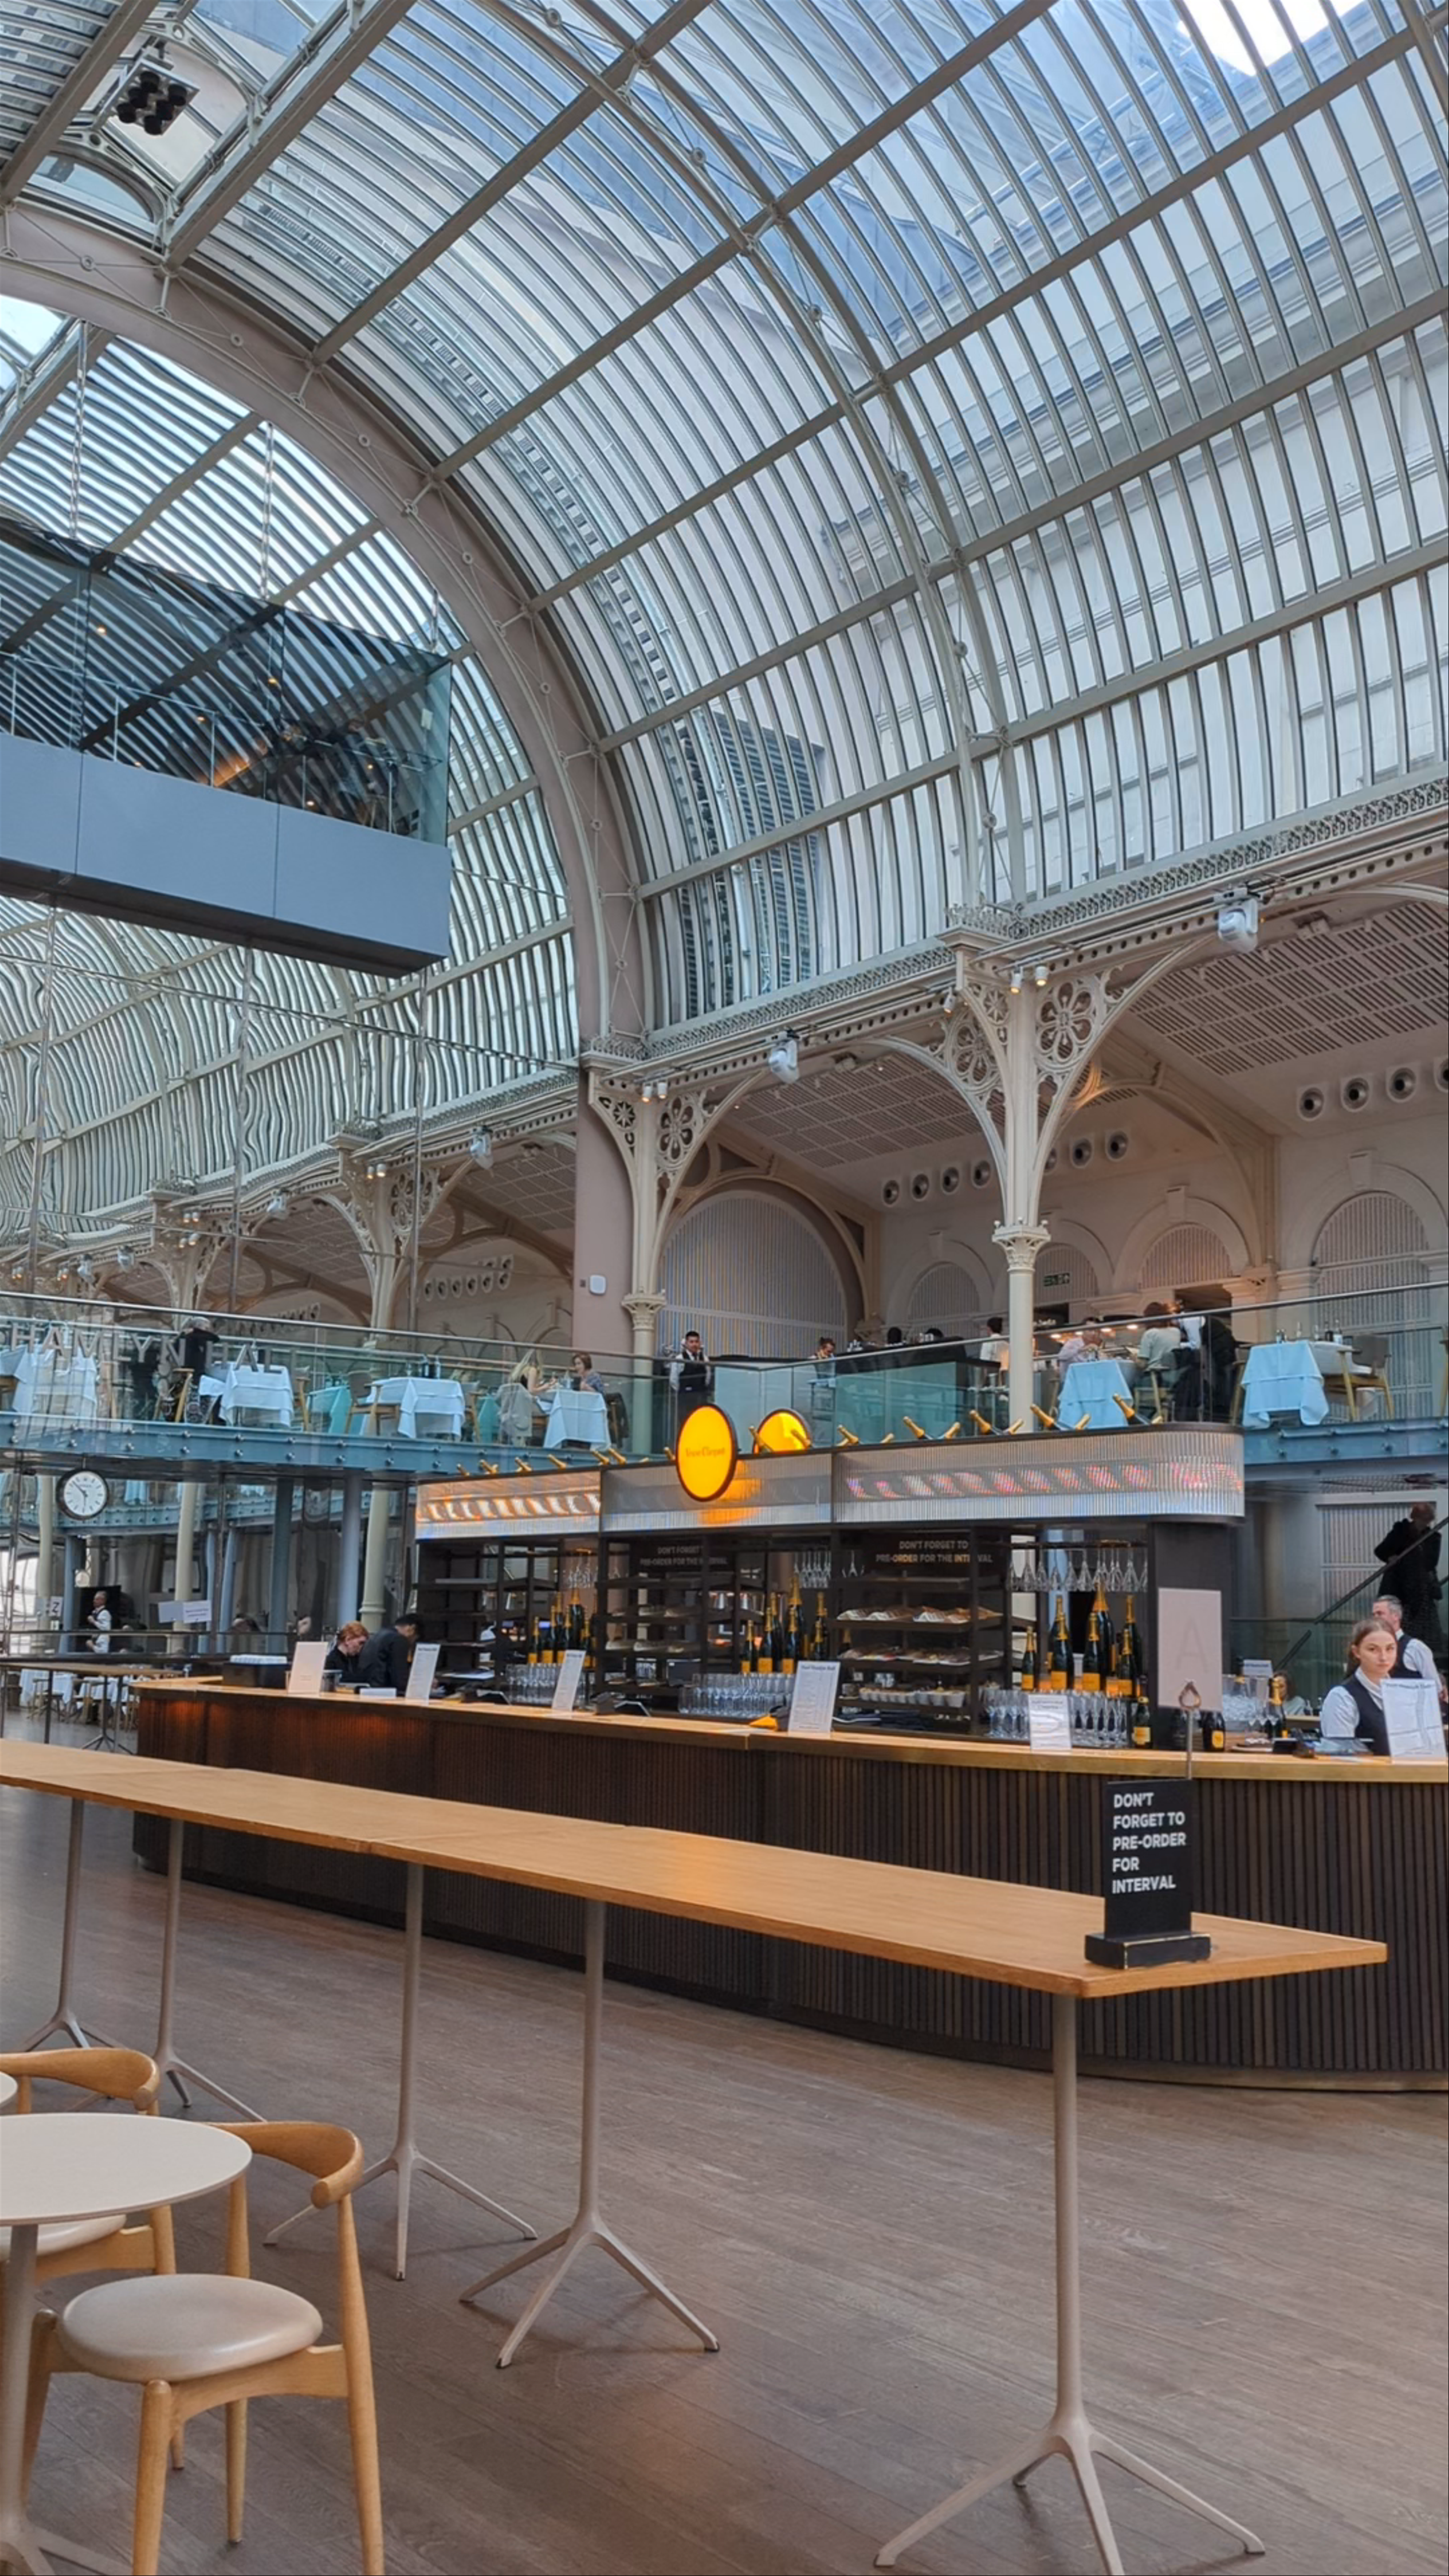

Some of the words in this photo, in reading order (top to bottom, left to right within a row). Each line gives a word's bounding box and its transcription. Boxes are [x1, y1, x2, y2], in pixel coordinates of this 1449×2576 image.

[11, 1322, 186, 1367] HAMLYN
[900, 1541, 922, 1549] DON'T
[924, 1541, 955, 1549] FORGET
[957, 1541, 969, 1549] TO
[875, 1554, 918, 1563] PRE-ORDER
[920, 1554, 935, 1563] FOR
[937, 1554, 953, 1563] THE
[1114, 1792, 1154, 1808] DON'T
[1113, 1813, 1165, 1829] FORGET
[1167, 1812, 1186, 1825] TO
[1112, 1832, 1186, 1851] PRE-ORDER
[1112, 1857, 1140, 1872] FOR
[1112, 1875, 1176, 1894] INTERVAL
